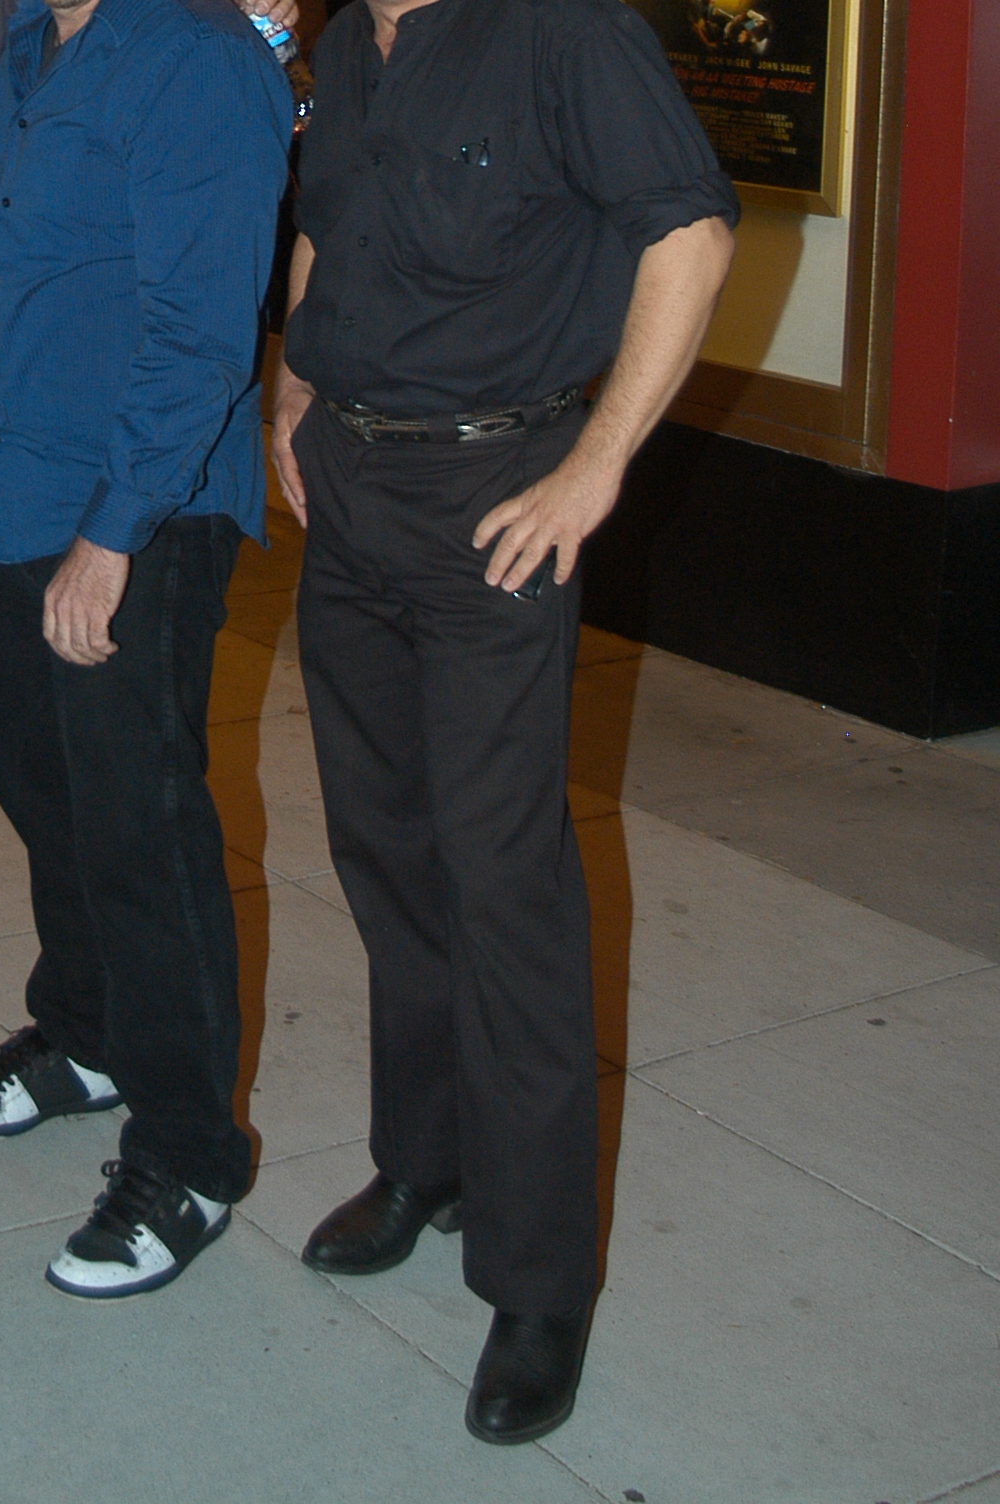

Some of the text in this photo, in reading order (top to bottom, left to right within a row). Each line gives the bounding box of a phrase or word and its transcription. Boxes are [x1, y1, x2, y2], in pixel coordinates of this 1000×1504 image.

[758, 60, 778, 71] JOHN
[781, 64, 812, 75] SAVAGE
[768, 78, 816, 94] HOSTAGE
